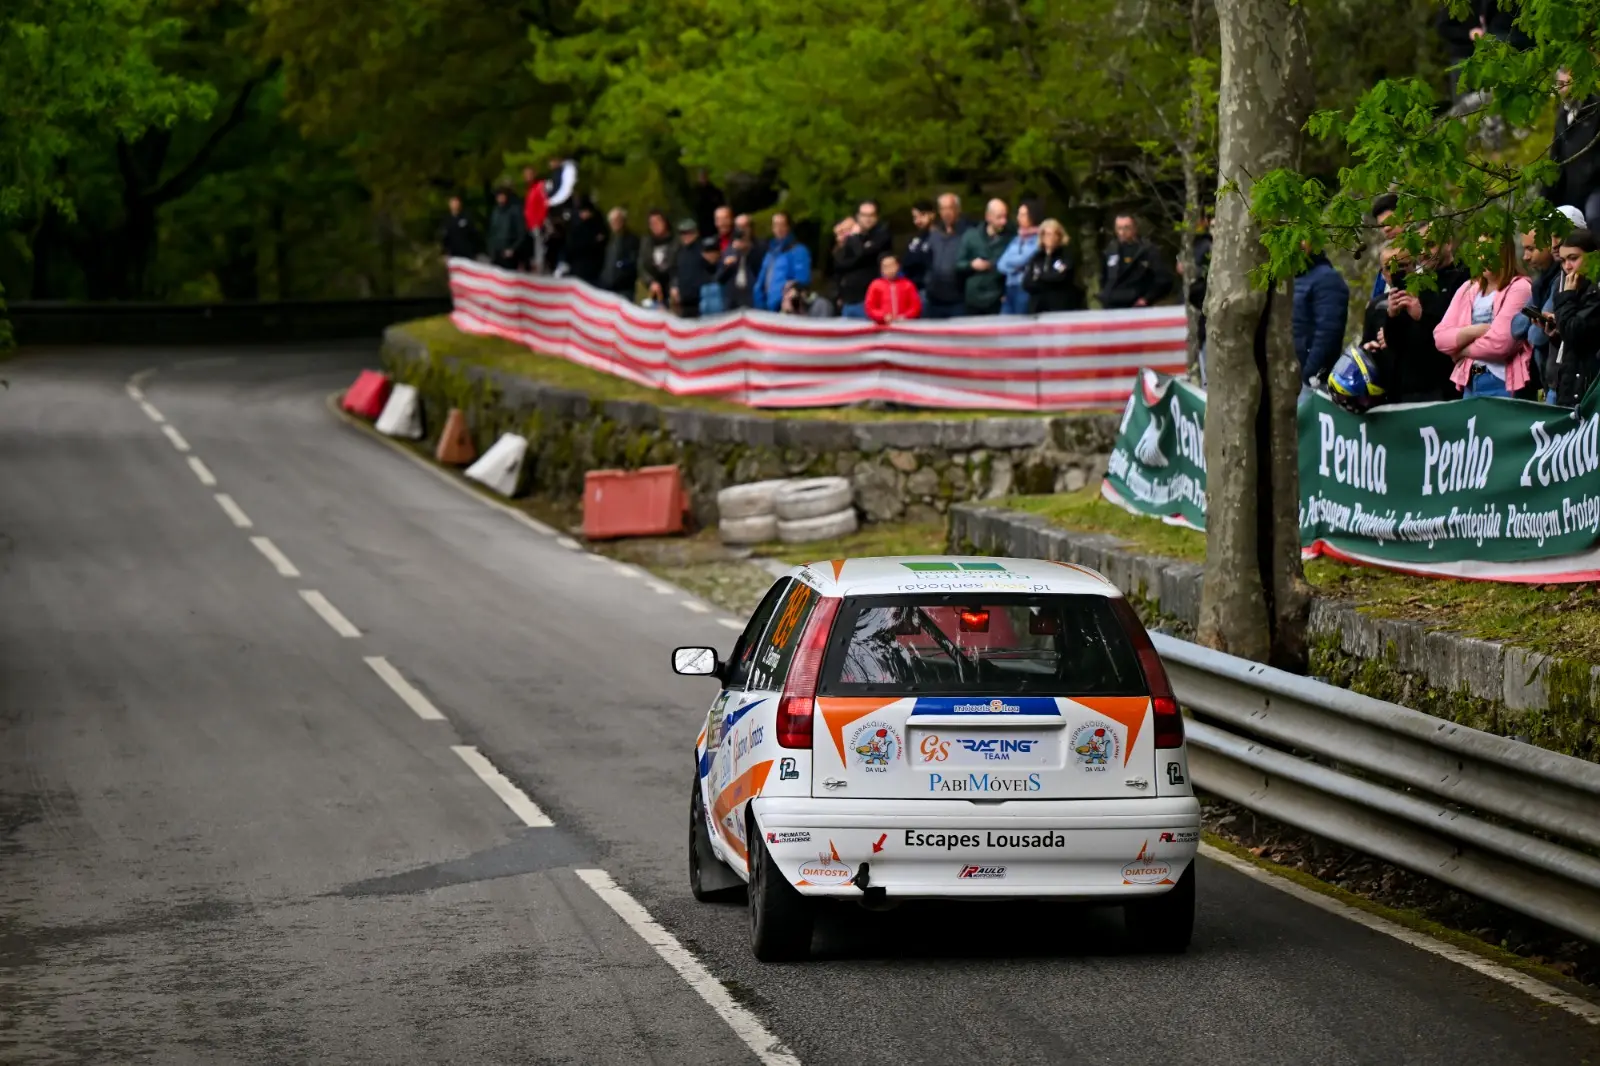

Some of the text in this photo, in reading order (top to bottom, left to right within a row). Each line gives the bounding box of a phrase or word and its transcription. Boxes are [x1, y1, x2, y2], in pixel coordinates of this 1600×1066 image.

[1170, 394, 1207, 473] Penh
[1318, 412, 1388, 495] Penha
[1419, 415, 1494, 496] Penha
[1304, 490, 1351, 533] Paisagem
[1448, 503, 1501, 548] Protegida
[1505, 503, 1562, 547] Paisagem
[1562, 494, 1600, 534] Proteg
[850, 720, 896, 751] CHURRASQUEIRA
[956, 739, 1039, 753] RACING
[1070, 720, 1114, 751] CHURRASQUEIRA
[904, 830, 1066, 851] Escapes Lousada
[802, 868, 849, 877] DIATOSTA
[1125, 867, 1168, 877] DIATOSTA
